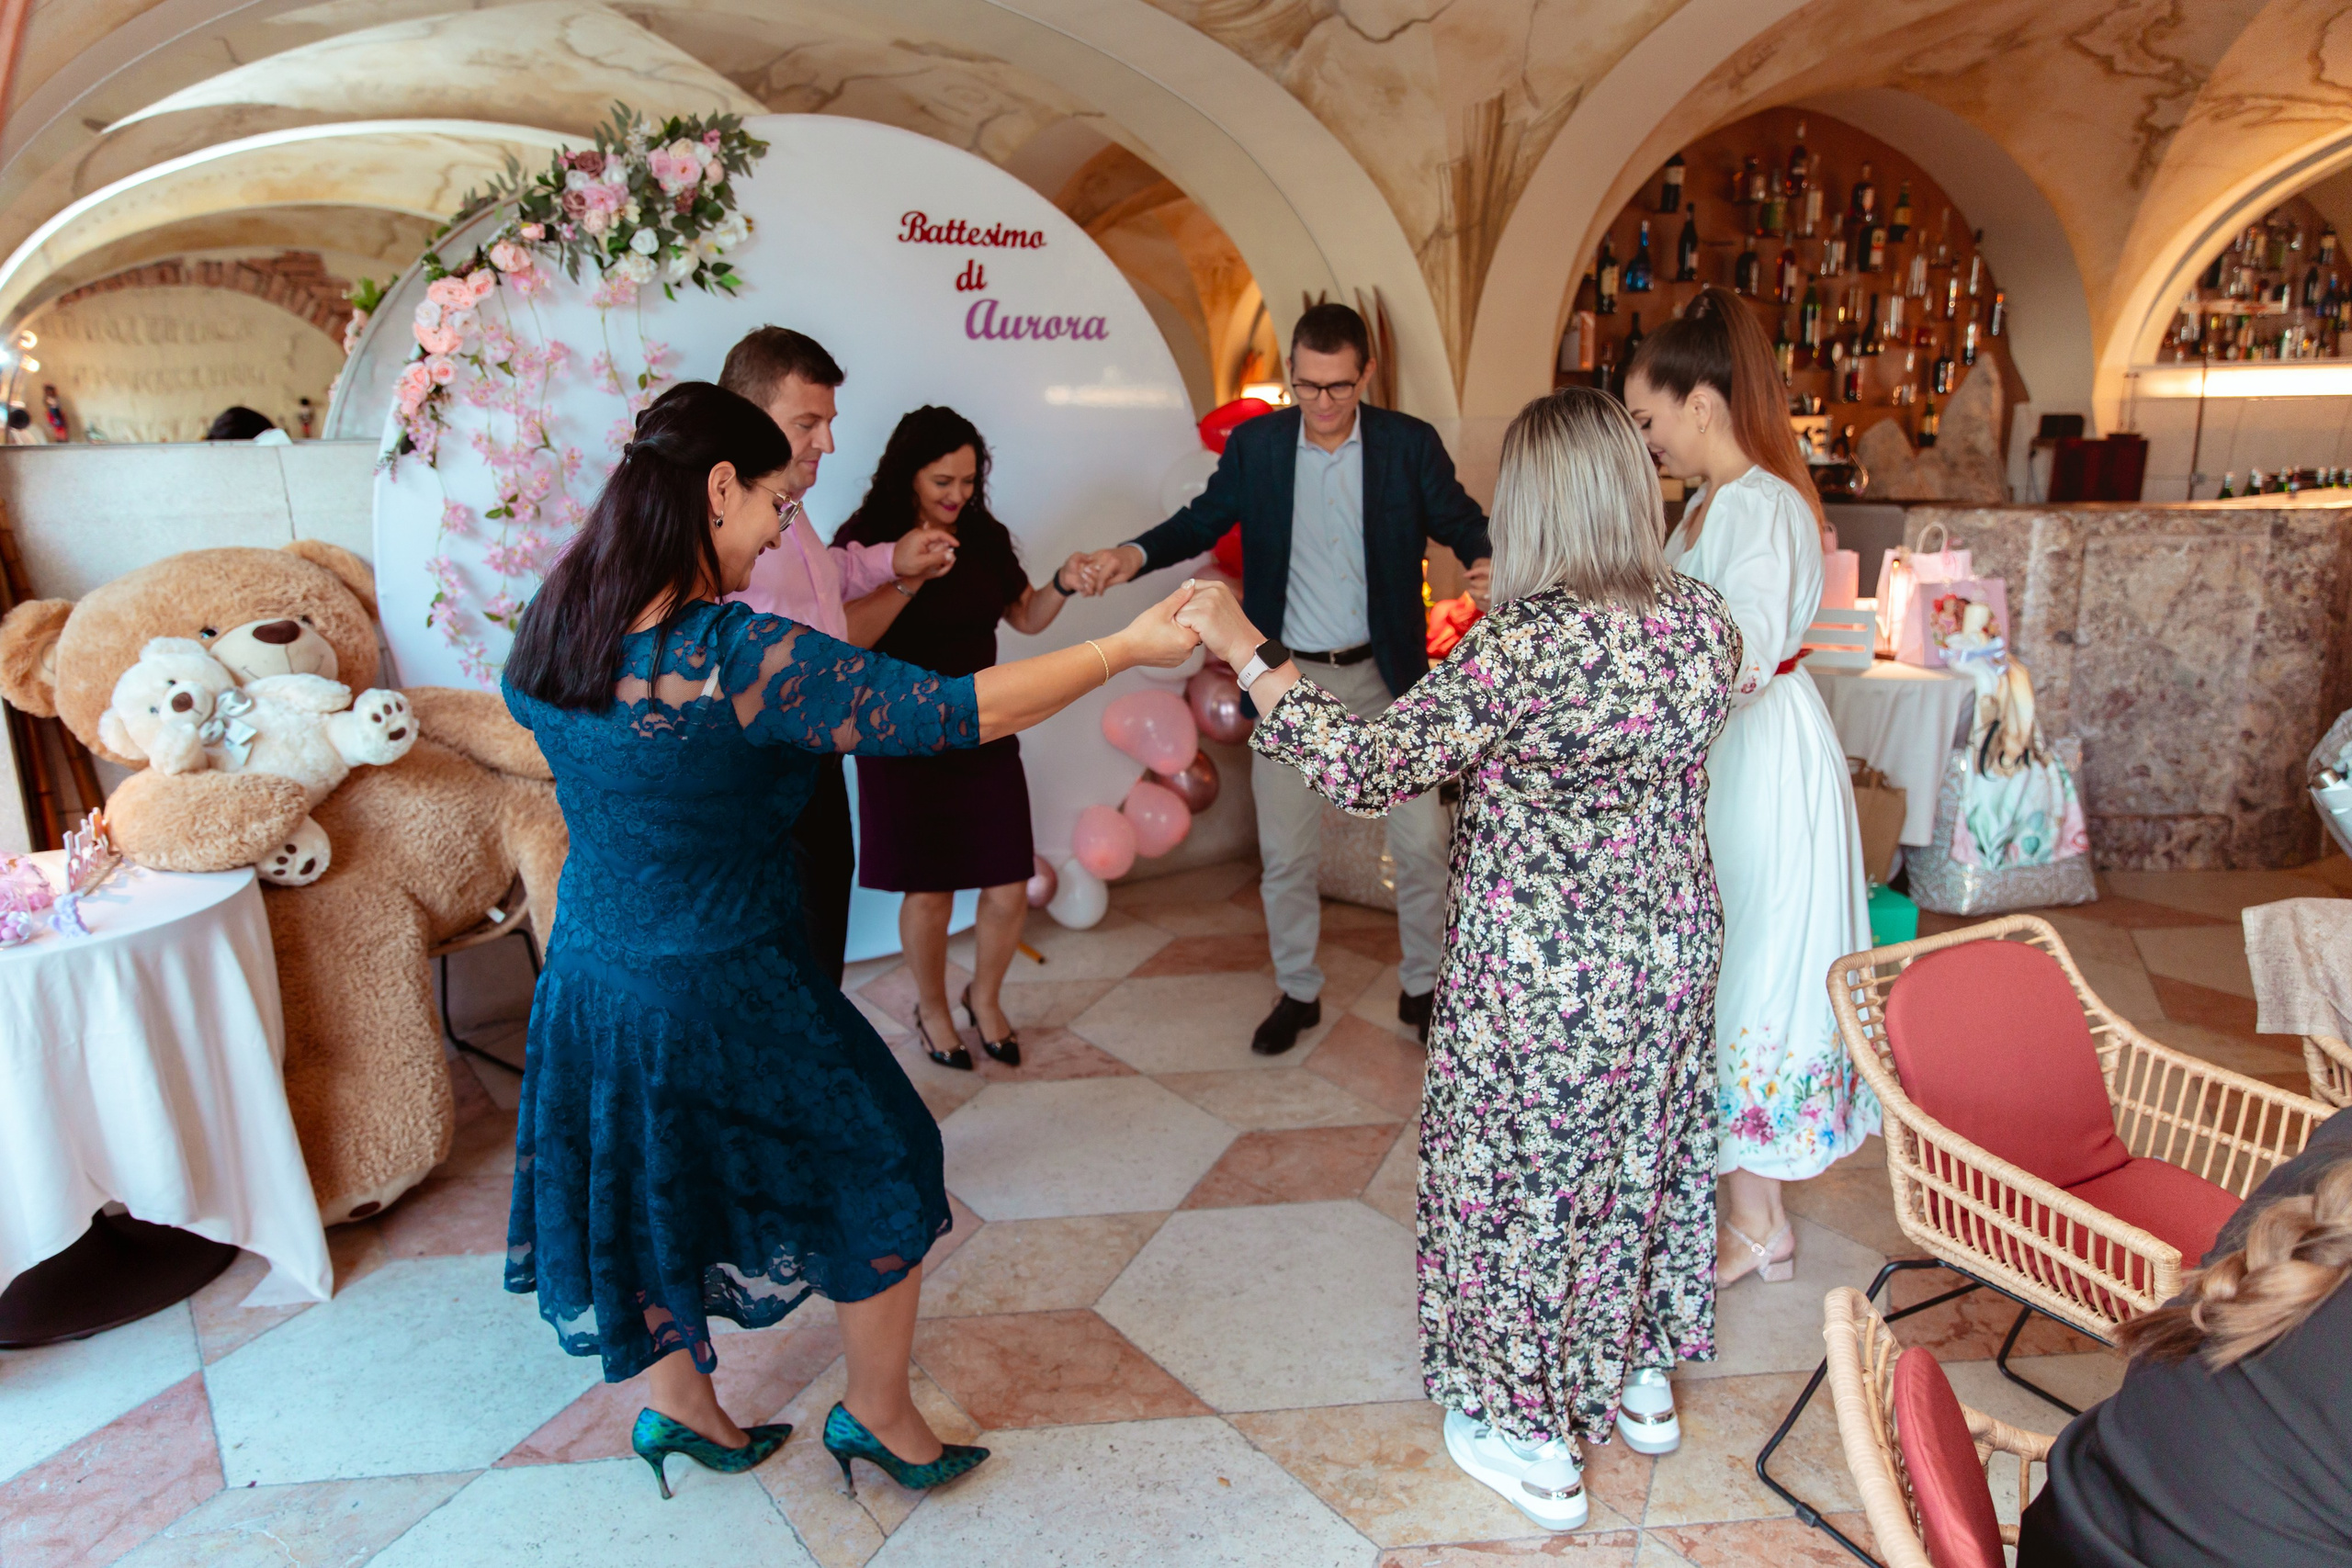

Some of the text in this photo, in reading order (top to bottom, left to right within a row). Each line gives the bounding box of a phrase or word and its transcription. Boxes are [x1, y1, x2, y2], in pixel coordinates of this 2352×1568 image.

[898, 210, 1046, 250] Battesimo
[956, 258, 988, 292] di
[965, 298, 1109, 341] Aurora
